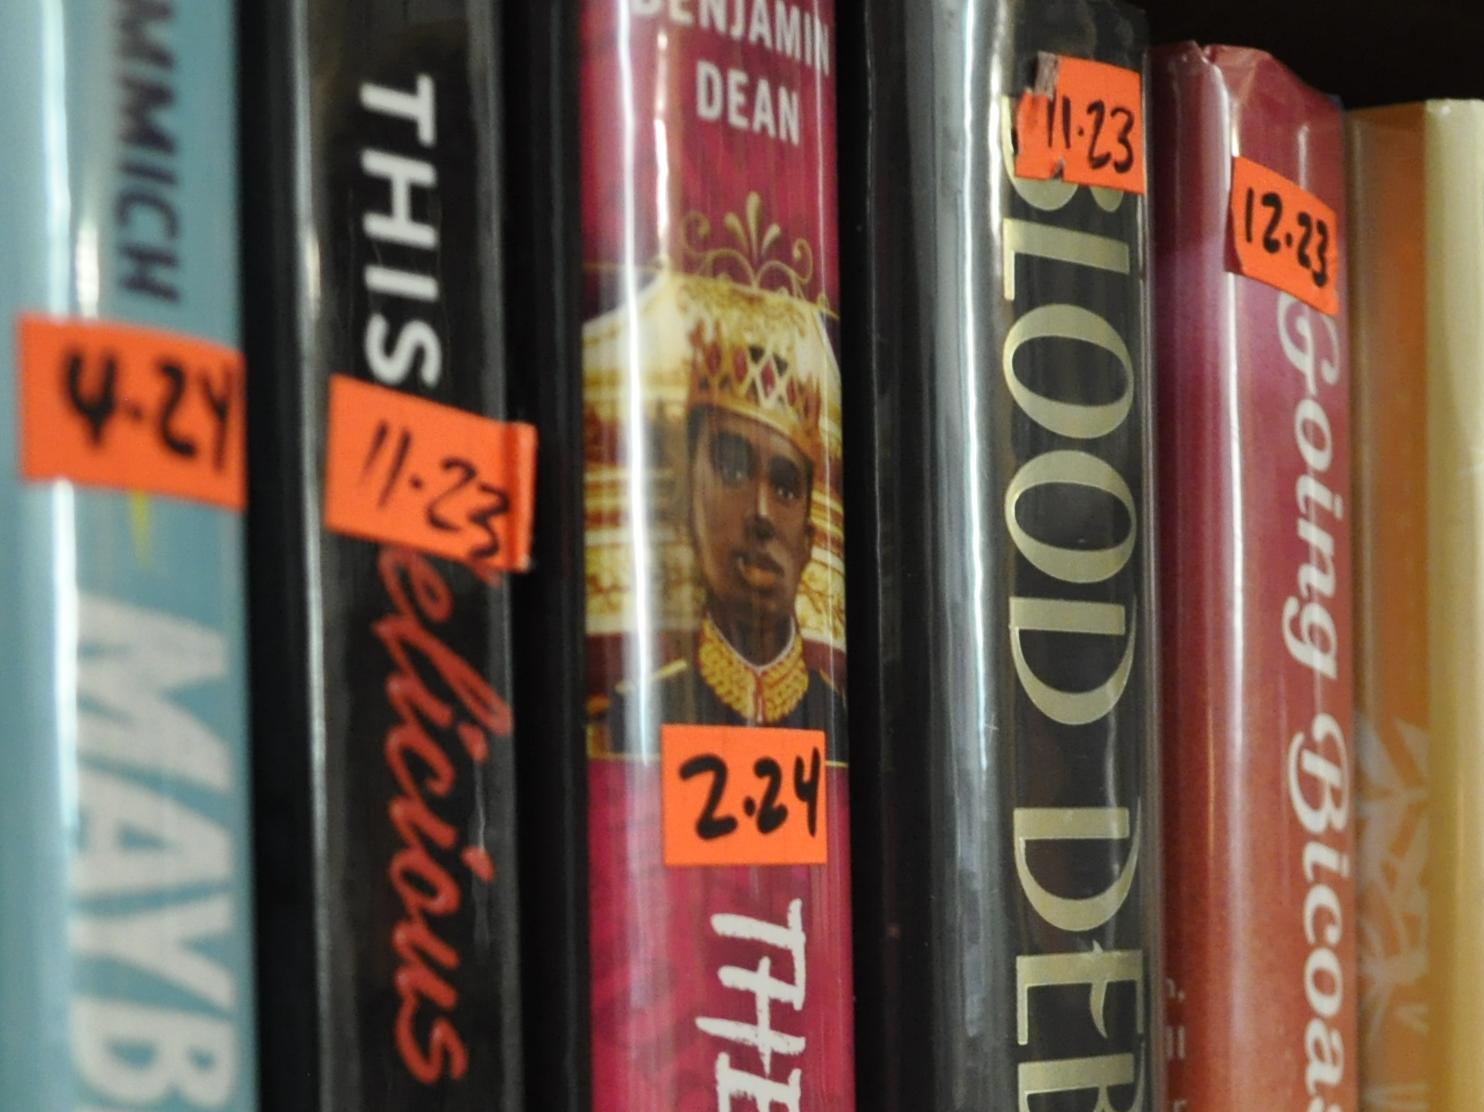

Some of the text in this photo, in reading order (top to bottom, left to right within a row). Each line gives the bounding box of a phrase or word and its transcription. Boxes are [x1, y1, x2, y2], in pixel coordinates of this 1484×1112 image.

[629, 0, 830, 76] NJAMIN
[695, 59, 800, 147] DEAN
[359, 73, 443, 388] THIS
[1242, 186, 1331, 290] 12.23
[361, 419, 509, 559] 11.23
[1277, 294, 1346, 681] Going
[371, 546, 514, 1085] elicious
[678, 747, 821, 842] 2.24
